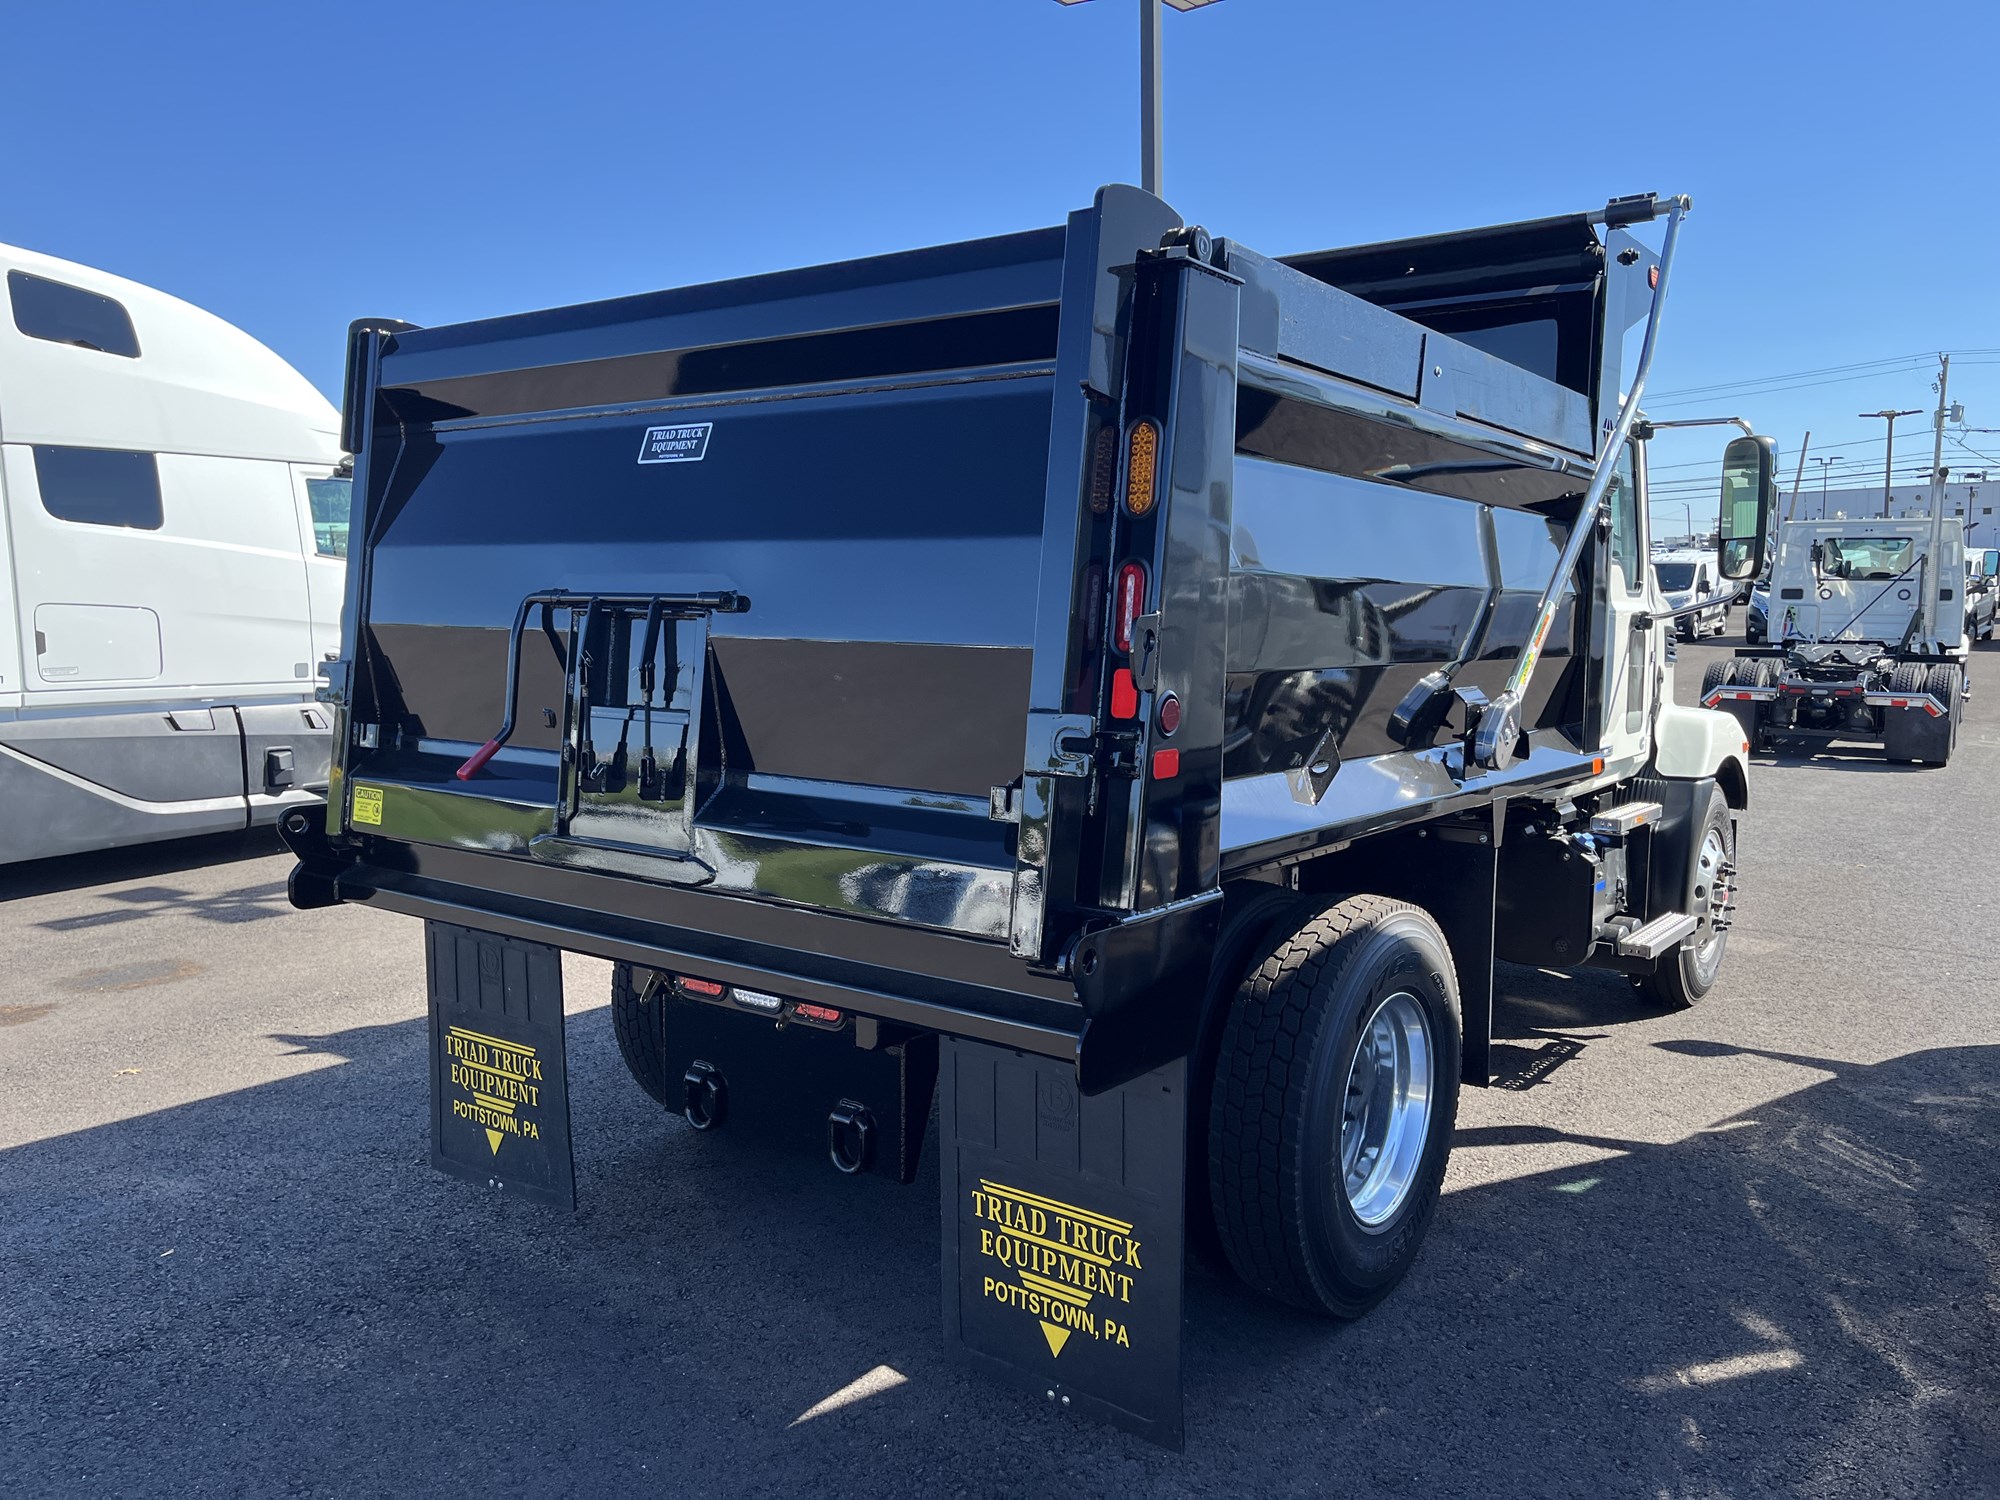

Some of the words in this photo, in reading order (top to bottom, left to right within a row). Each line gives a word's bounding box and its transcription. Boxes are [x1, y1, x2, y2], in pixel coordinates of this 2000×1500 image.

[651, 440, 697, 453] EQUIPMENT
[652, 430, 676, 440] TRIAD
[677, 428, 704, 439] TRUCK
[356, 789, 382, 801] CAUTION
[444, 1035, 488, 1064] TRIAD
[492, 1048, 543, 1081] TRUCK
[450, 1063, 539, 1107] EQUIPMENT
[453, 1099, 521, 1138] POTTSTOWN,
[523, 1120, 540, 1140] PA
[971, 1191, 1047, 1236] TRIAD
[1055, 1216, 1142, 1270] TRUCK
[980, 1228, 1134, 1304] EQUIPMENT
[983, 1276, 1099, 1339] POTTSTOWN,
[1104, 1319, 1131, 1348] PA
